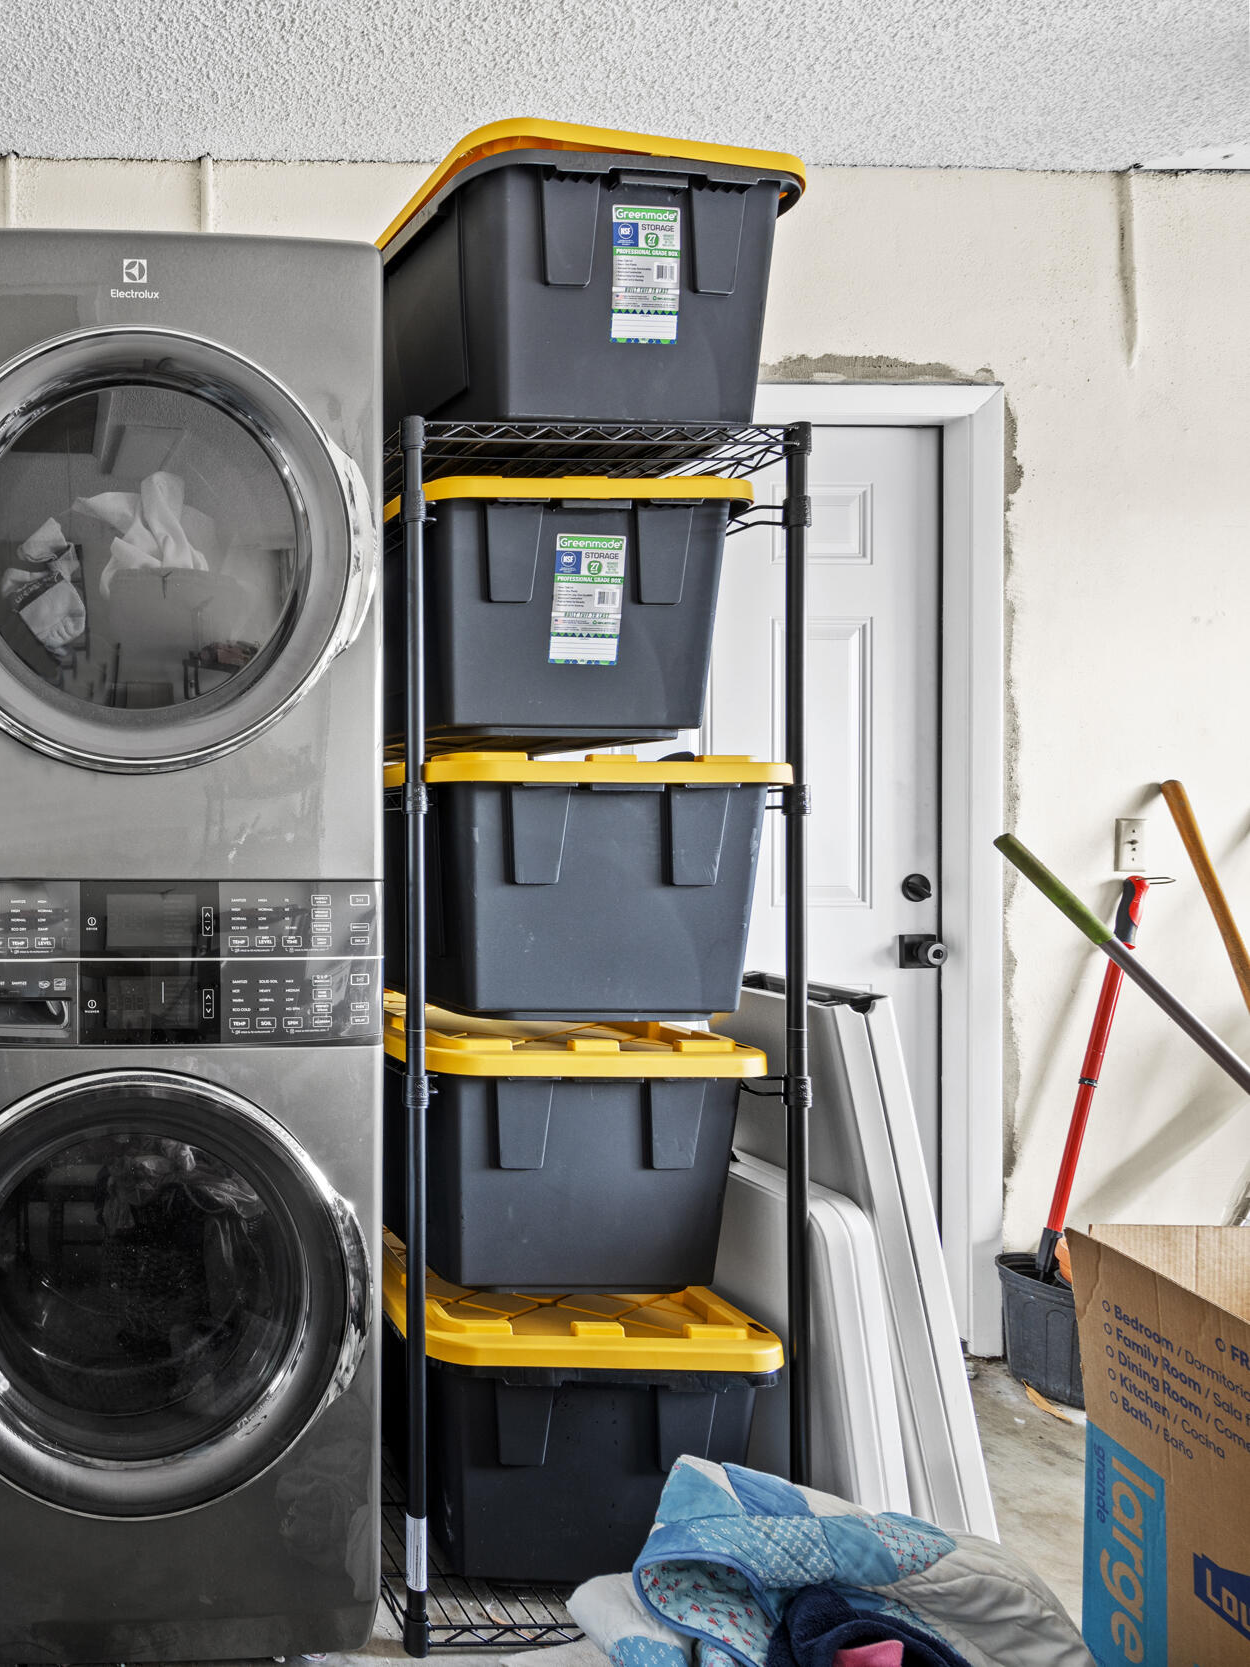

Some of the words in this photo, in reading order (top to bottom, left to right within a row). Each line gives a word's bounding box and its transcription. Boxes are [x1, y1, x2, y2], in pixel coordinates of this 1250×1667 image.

[616, 208, 675, 221] Greenmade
[641, 223, 675, 232] STORAGE
[647, 234, 657, 243] 27
[615, 248, 651, 256] PROFESSIONAL
[110, 289, 159, 299] Electrolux
[560, 537, 621, 550] Greenmade
[584, 551, 619, 560] STORAGE
[590, 562, 600, 571] 27
[1113, 1304, 1174, 1352] Bedroom
[1116, 1327, 1159, 1368] Family
[1162, 1356, 1202, 1396] Room
[1213, 1392, 1243, 1421] Sala
[1118, 1350, 1160, 1393] Dining
[1162, 1379, 1203, 1419] Room
[1120, 1372, 1171, 1420] Kitchen
[1181, 1418, 1225, 1459] Cocina
[1122, 1396, 1153, 1430] Bath
[1163, 1429, 1194, 1460] Baño
[1093, 1442, 1109, 1524] grande
[1100, 1455, 1156, 1664] large
